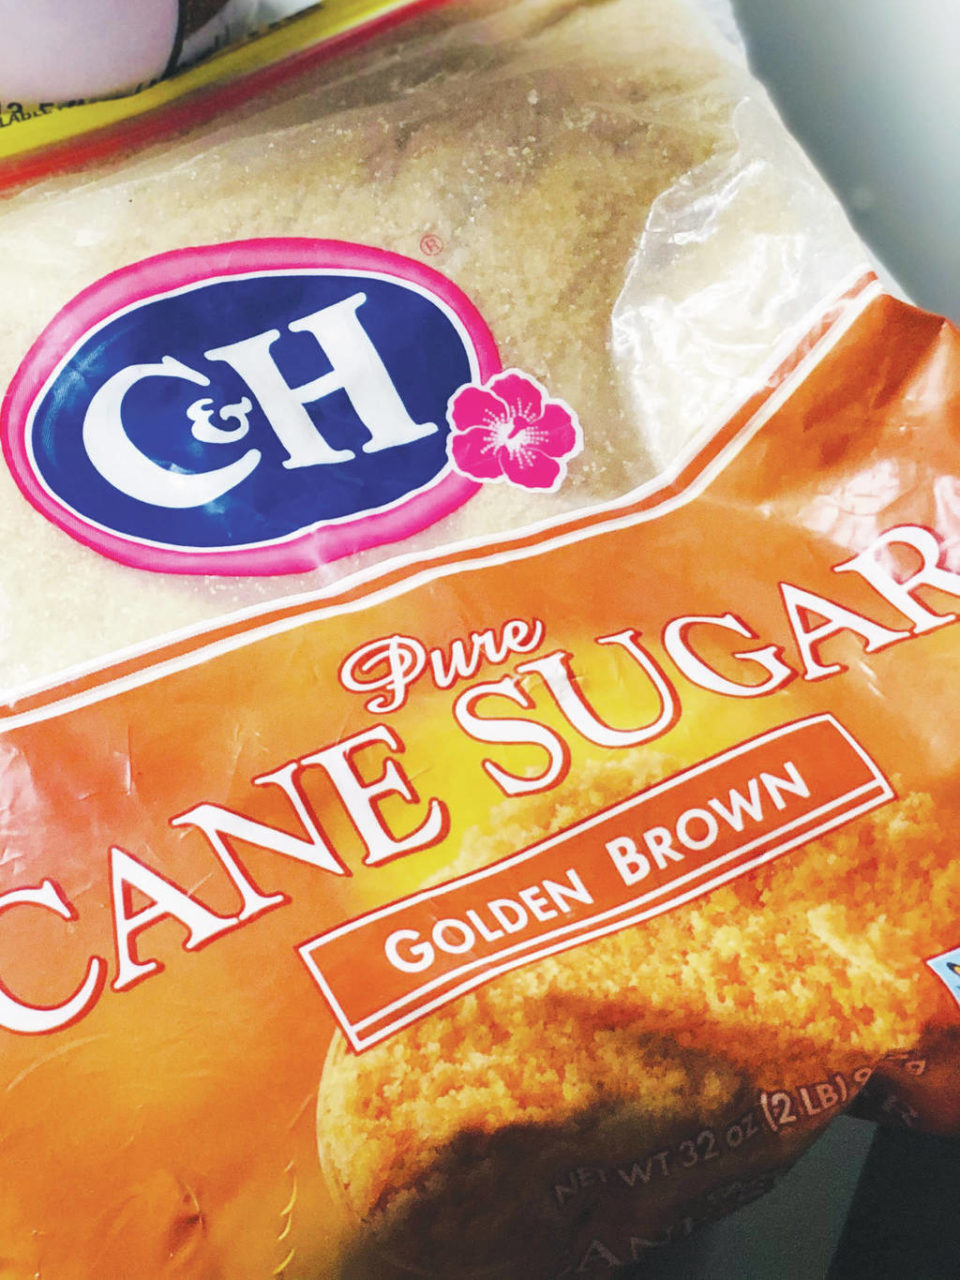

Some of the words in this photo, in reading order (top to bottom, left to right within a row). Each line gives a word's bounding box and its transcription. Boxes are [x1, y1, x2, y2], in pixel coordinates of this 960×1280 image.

[82, 291, 439, 509] C&H
[340, 618, 542, 712] Pure
[453, 523, 960, 795] SUGAR
[385, 869, 594, 973] GOLDEN
[605, 761, 810, 886] BROWN
[619, 1150, 672, 1188] WT
[680, 1130, 719, 1168] 32
[802, 1074, 848, 1116] LB)
